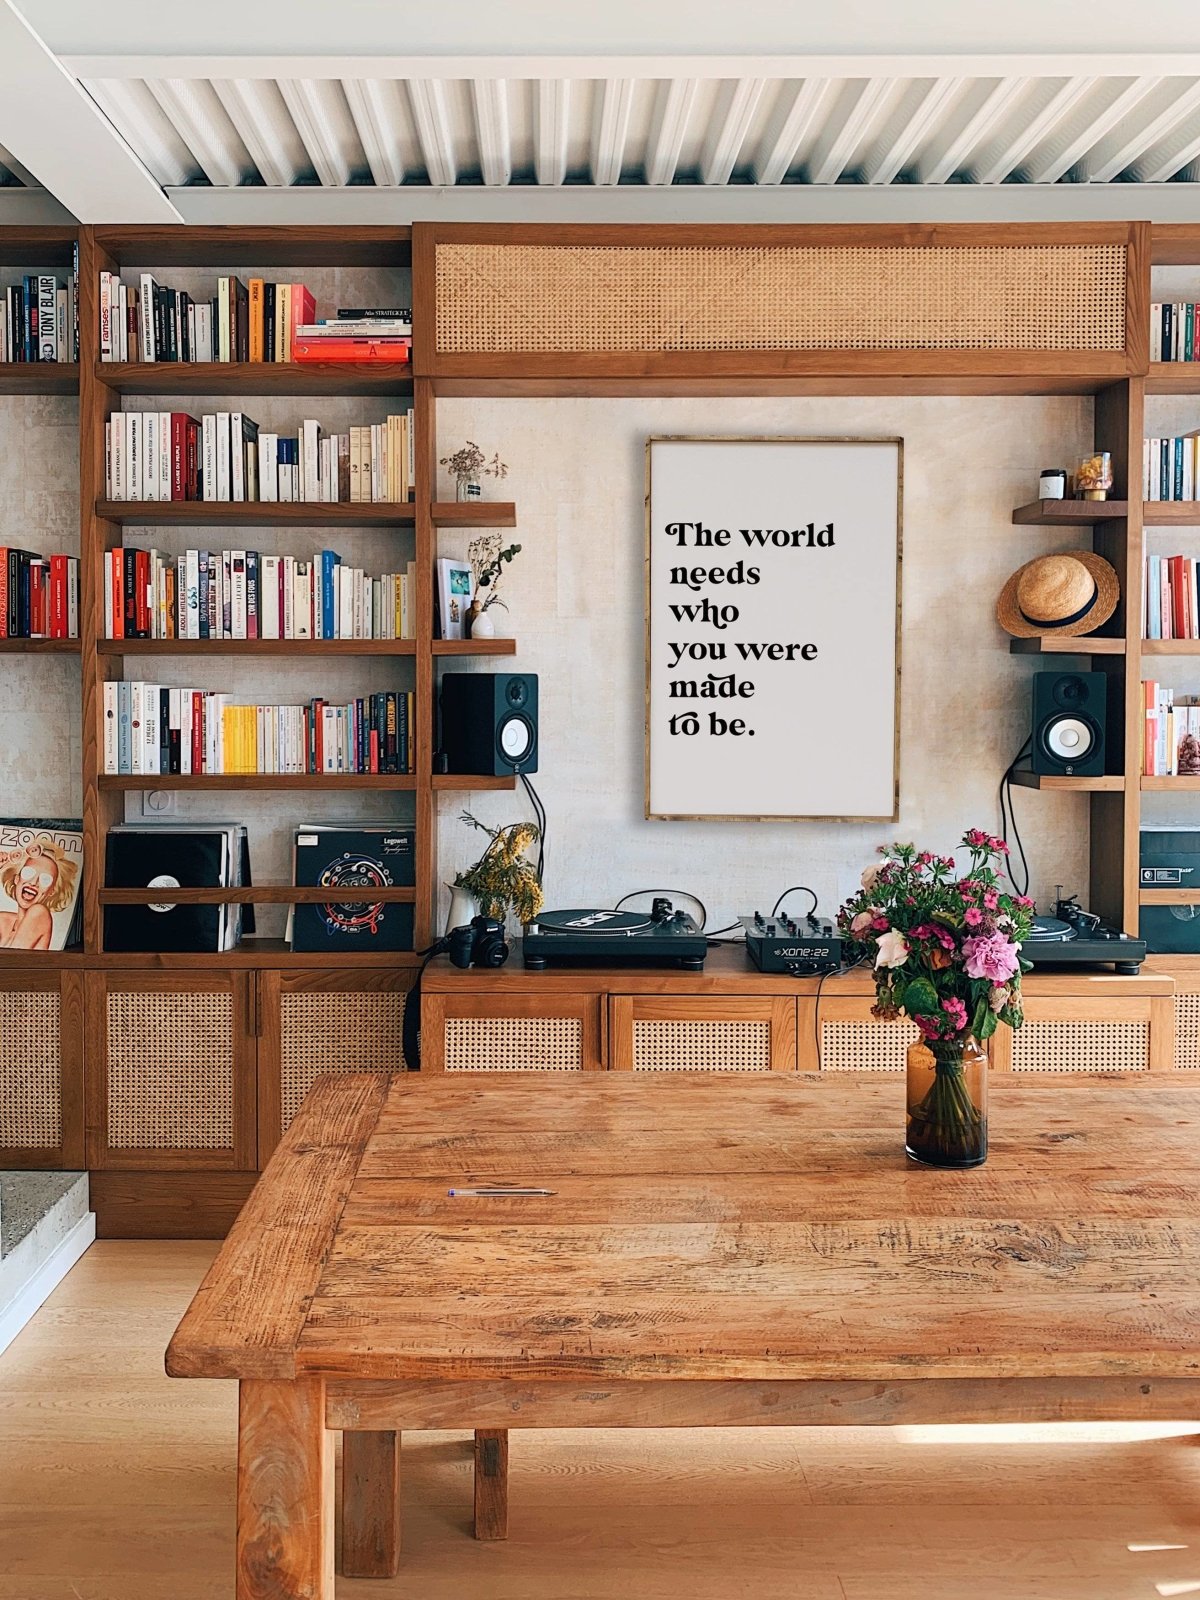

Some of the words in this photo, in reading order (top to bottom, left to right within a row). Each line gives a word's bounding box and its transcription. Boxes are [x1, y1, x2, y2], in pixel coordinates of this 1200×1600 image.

[40, 278, 55, 307] BLAIR
[40, 310, 55, 338] TONY
[175, 462, 181, 470] DU
[664, 522, 731, 547] The
[739, 522, 836, 548] world
[247, 579, 256, 593] FOUS
[669, 560, 761, 592] needs
[199, 580, 207, 603] Masters
[247, 594, 256, 603] DES
[668, 598, 740, 630] who
[667, 642, 727, 669] you
[735, 643, 818, 661] were
[668, 673, 755, 699] made
[387, 701, 396, 735] UNDERCOVER
[668, 711, 700, 736] to
[709, 711, 756, 737] be.
